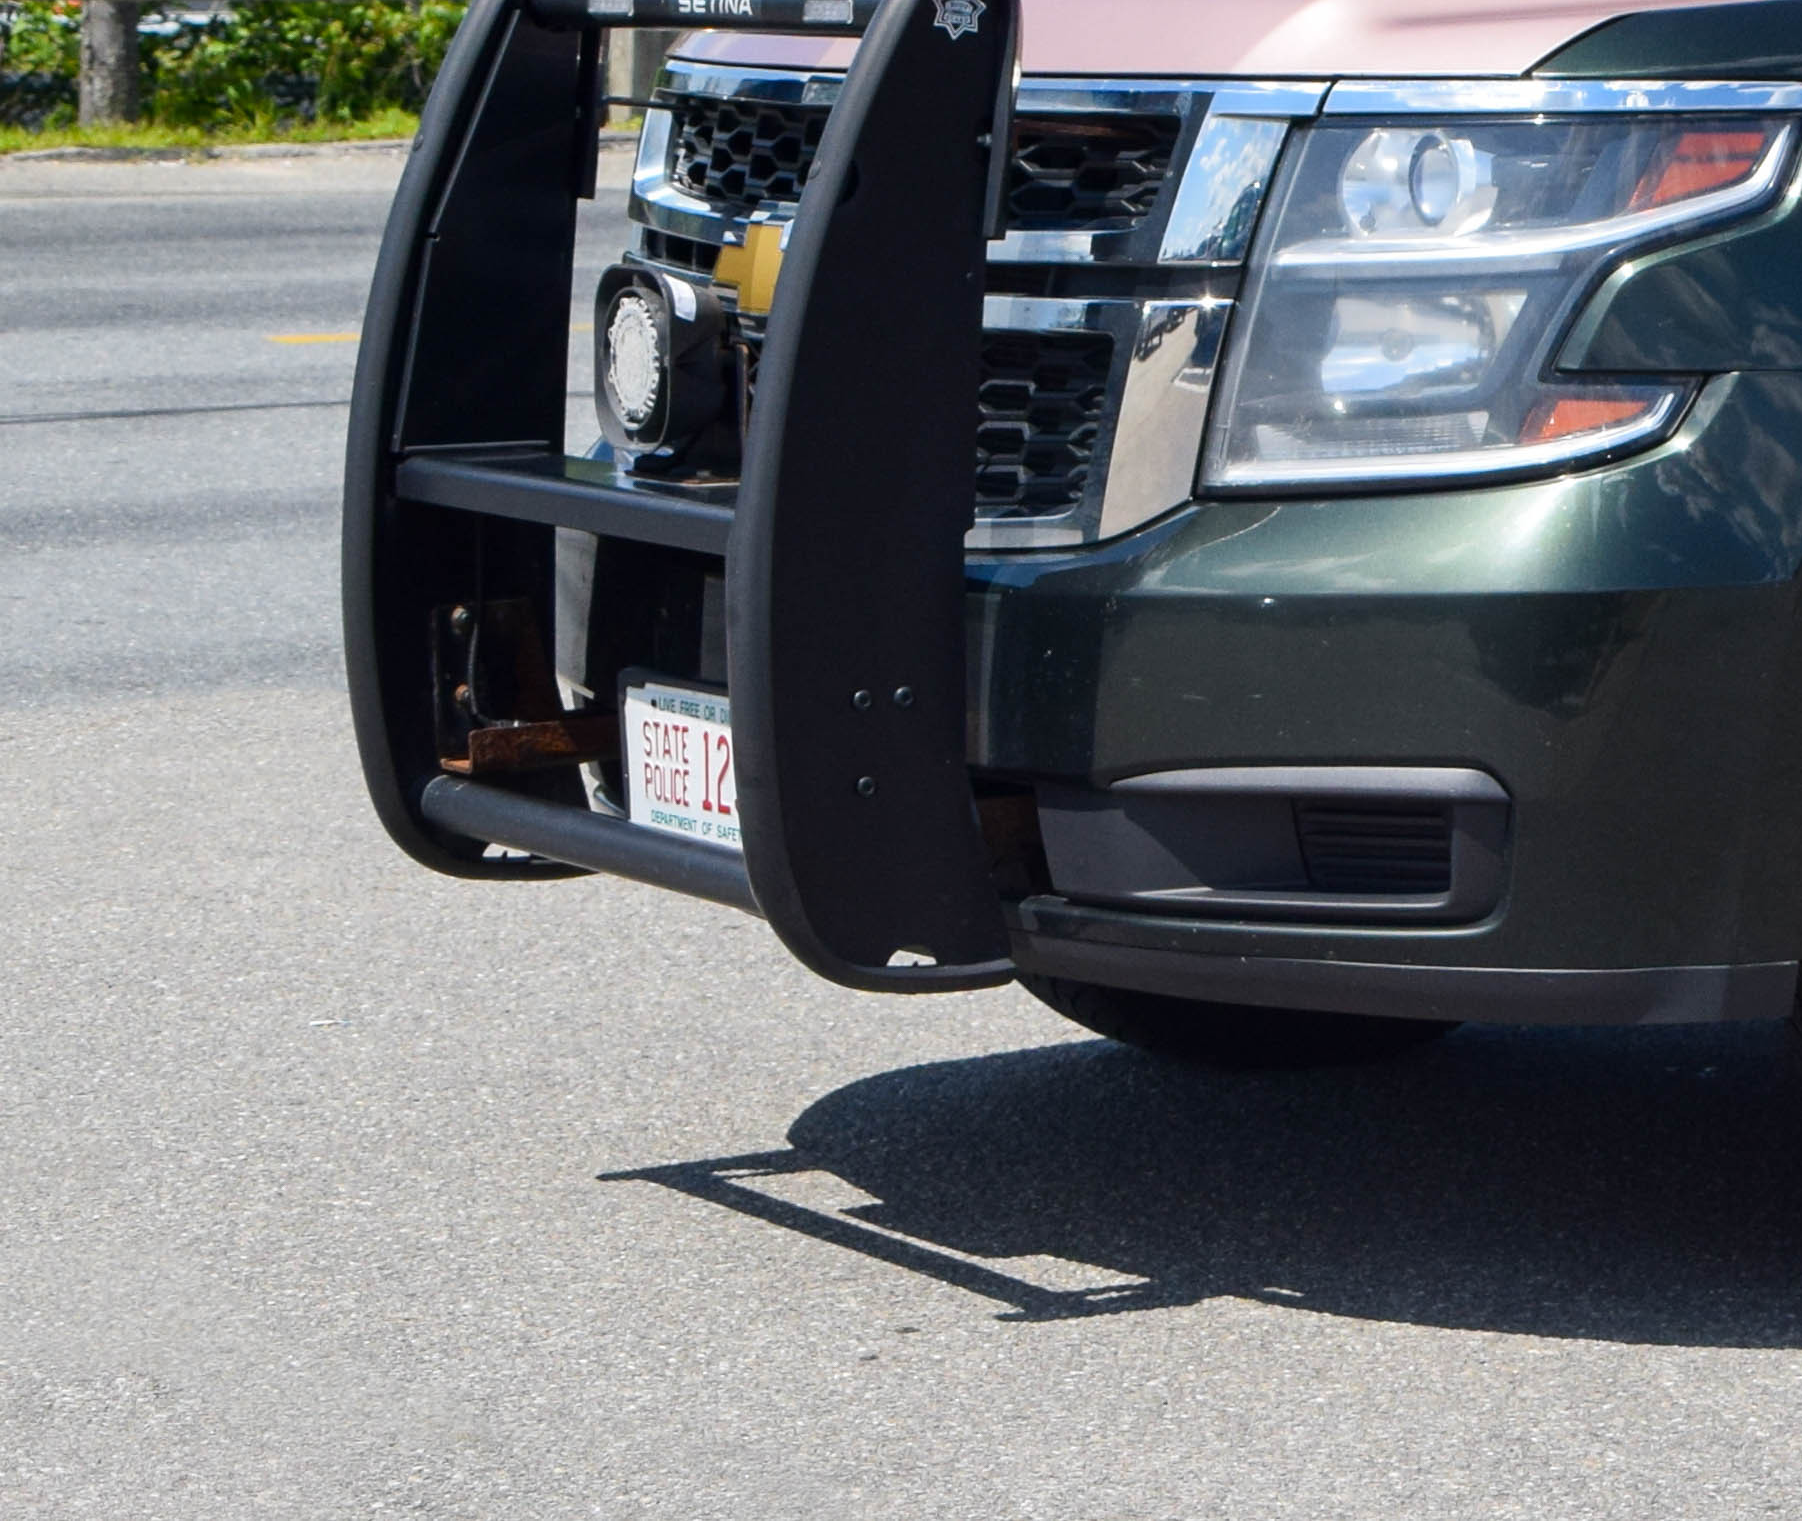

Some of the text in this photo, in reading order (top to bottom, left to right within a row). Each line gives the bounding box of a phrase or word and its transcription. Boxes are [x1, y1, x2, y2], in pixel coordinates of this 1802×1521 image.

[659, 695, 676, 714] LIVE
[680, 699, 701, 719] FREE
[704, 705, 716, 721] OR
[643, 720, 689, 764] STATE
[644, 763, 690, 808] POLICE
[702, 730, 738, 817] 12
[651, 809, 741, 843] DEPARTMENT OF SAFET
